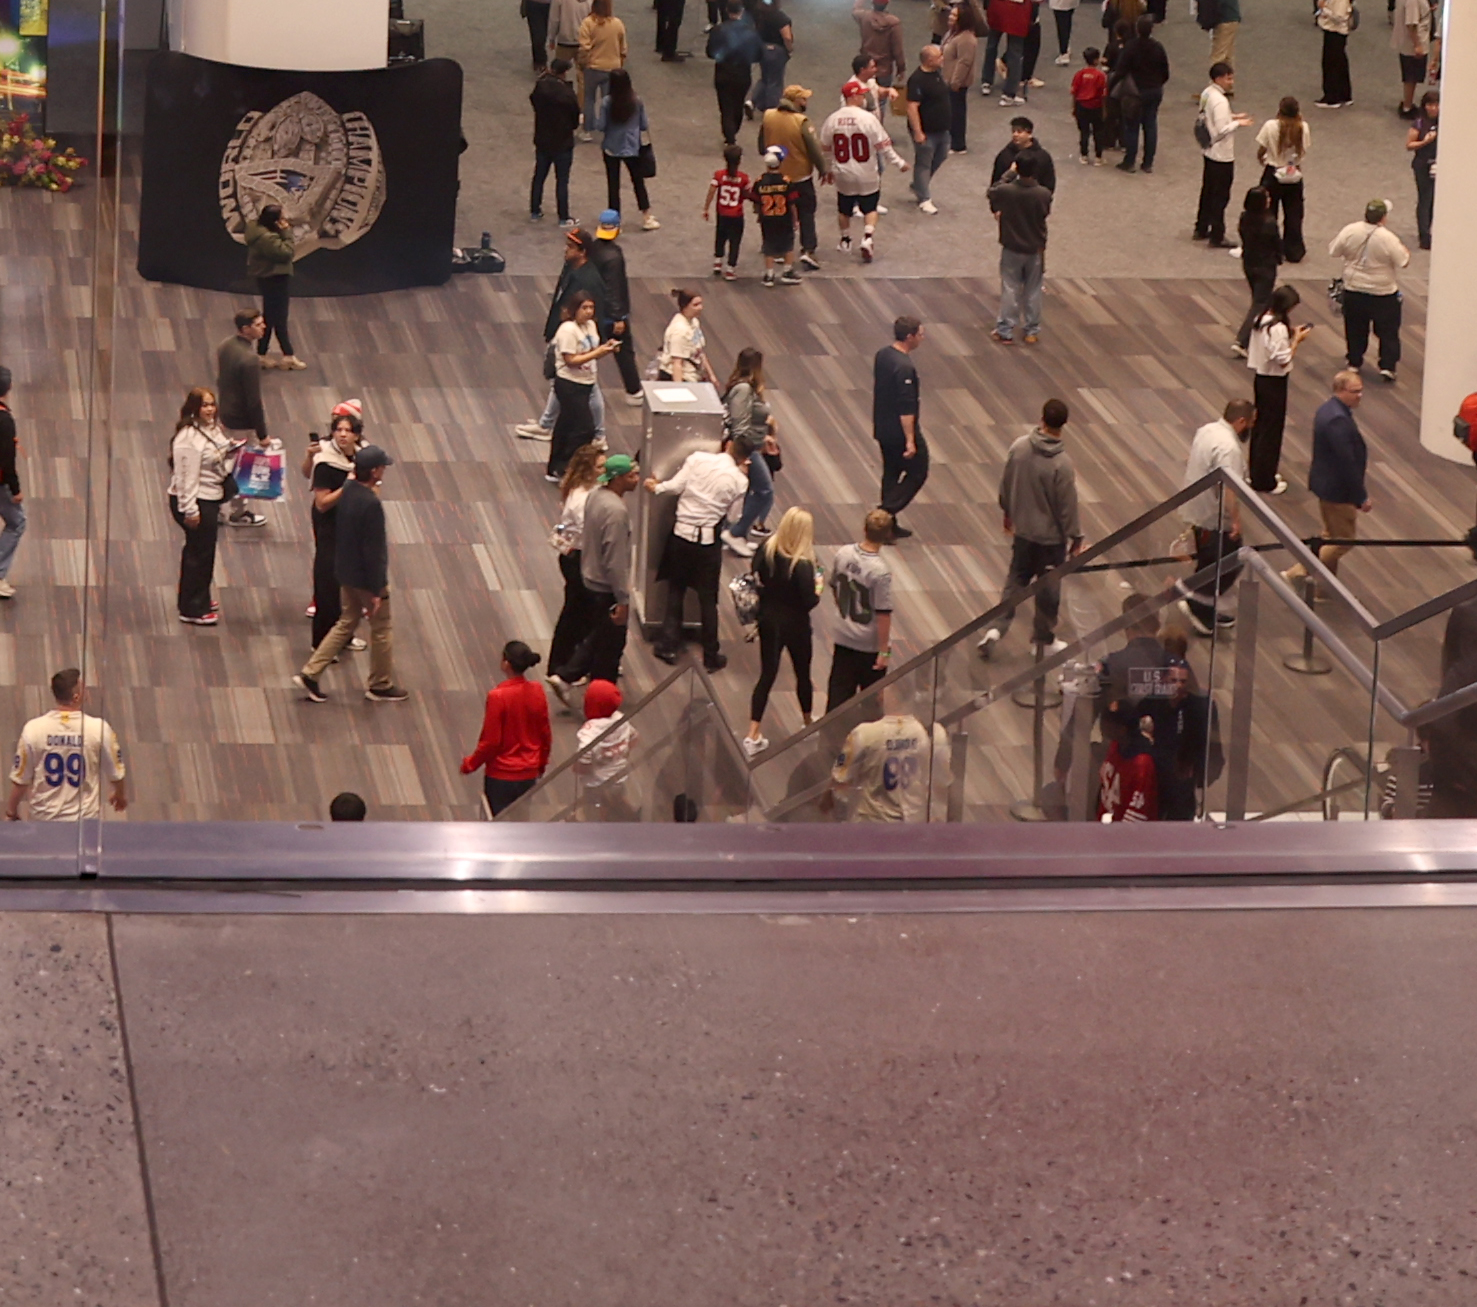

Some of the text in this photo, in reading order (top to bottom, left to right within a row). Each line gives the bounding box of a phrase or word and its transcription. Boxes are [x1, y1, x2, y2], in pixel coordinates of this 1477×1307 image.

[833, 132, 871, 164] 80
[319, 111, 373, 239] CHAMPIONS
[719, 185, 741, 207] 53
[760, 194, 788, 217] 23
[46, 734, 83, 747] DONALD
[44, 752, 86, 788] 99
